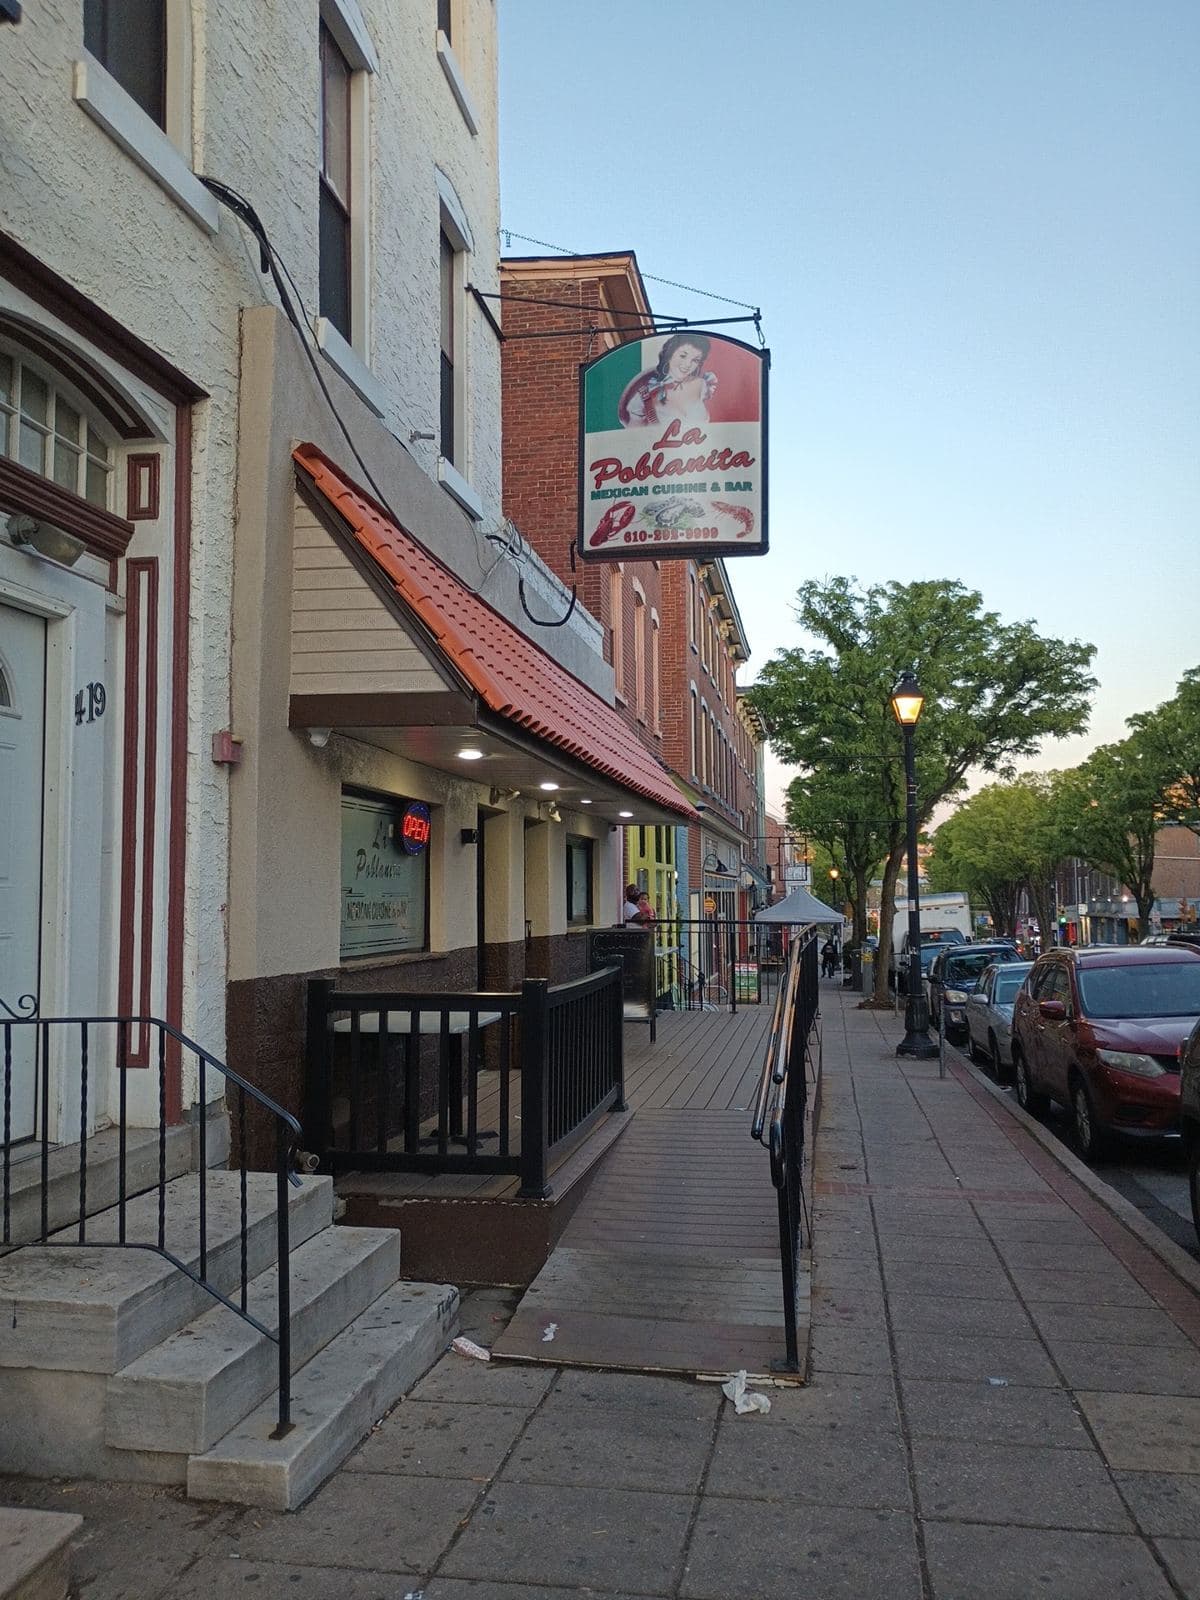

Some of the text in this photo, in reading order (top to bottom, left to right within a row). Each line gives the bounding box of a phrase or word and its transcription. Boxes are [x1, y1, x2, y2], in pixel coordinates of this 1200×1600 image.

[652, 418, 707, 450] La
[590, 448, 756, 489] Poblanita
[590, 481, 753, 500] MEXICAN CUISINE & BAR
[74, 682, 106, 726] 419
[403, 815, 431, 843] OPEN
